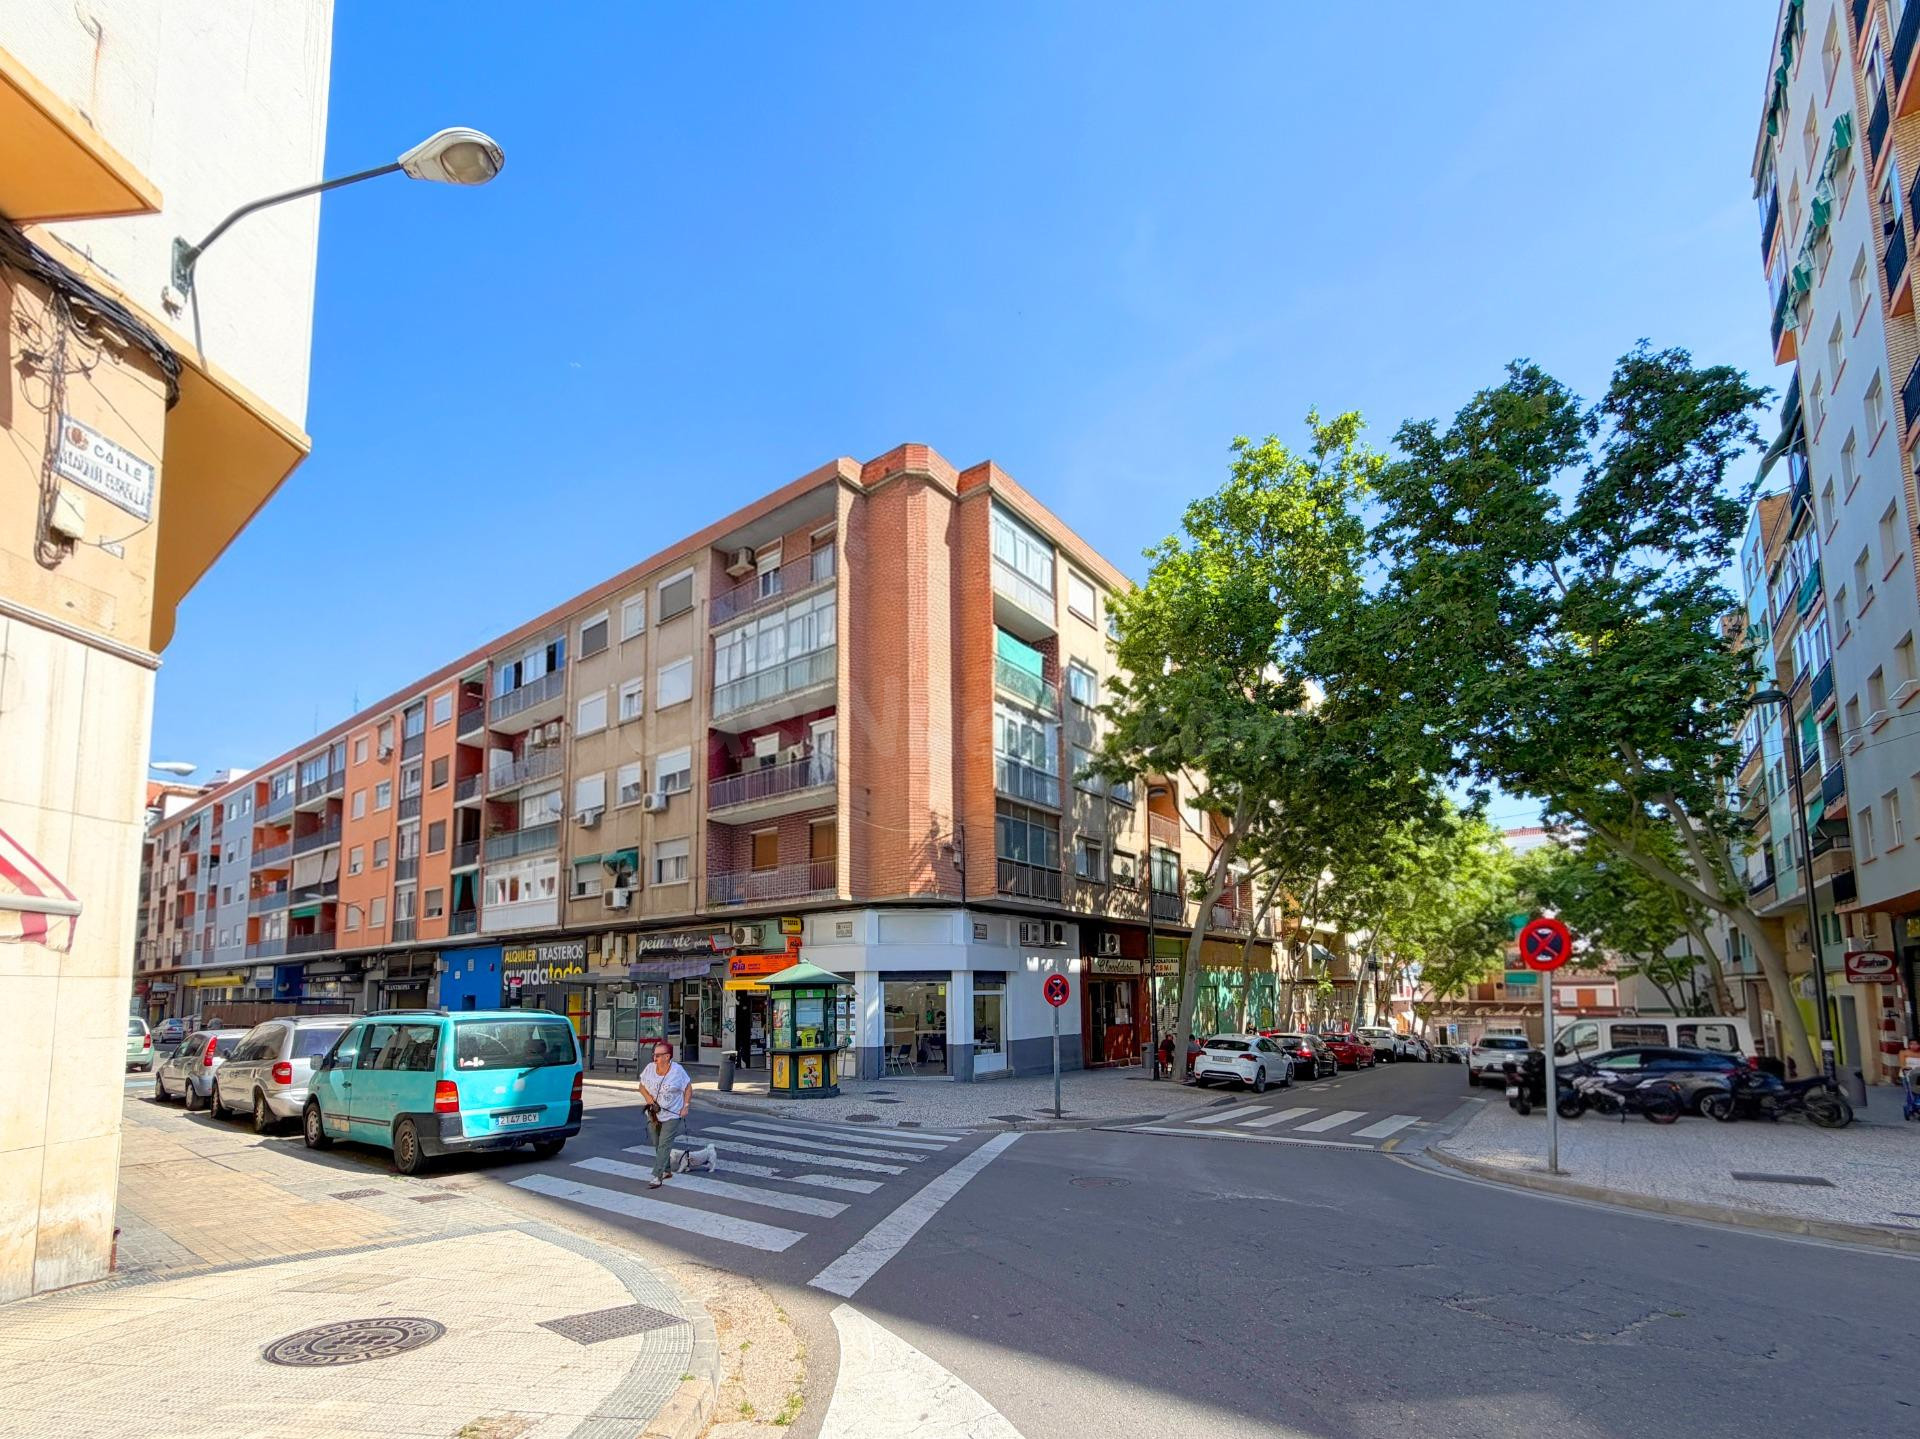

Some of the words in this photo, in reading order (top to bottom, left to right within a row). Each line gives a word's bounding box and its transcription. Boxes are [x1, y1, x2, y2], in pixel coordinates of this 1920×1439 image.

[93, 444, 142, 482] CALLE
[504, 949, 537, 963] ALQUILER
[539, 944, 584, 961] TRASTEROS
[732, 960, 746, 971] Ria
[522, 1112, 538, 1123] BCY
